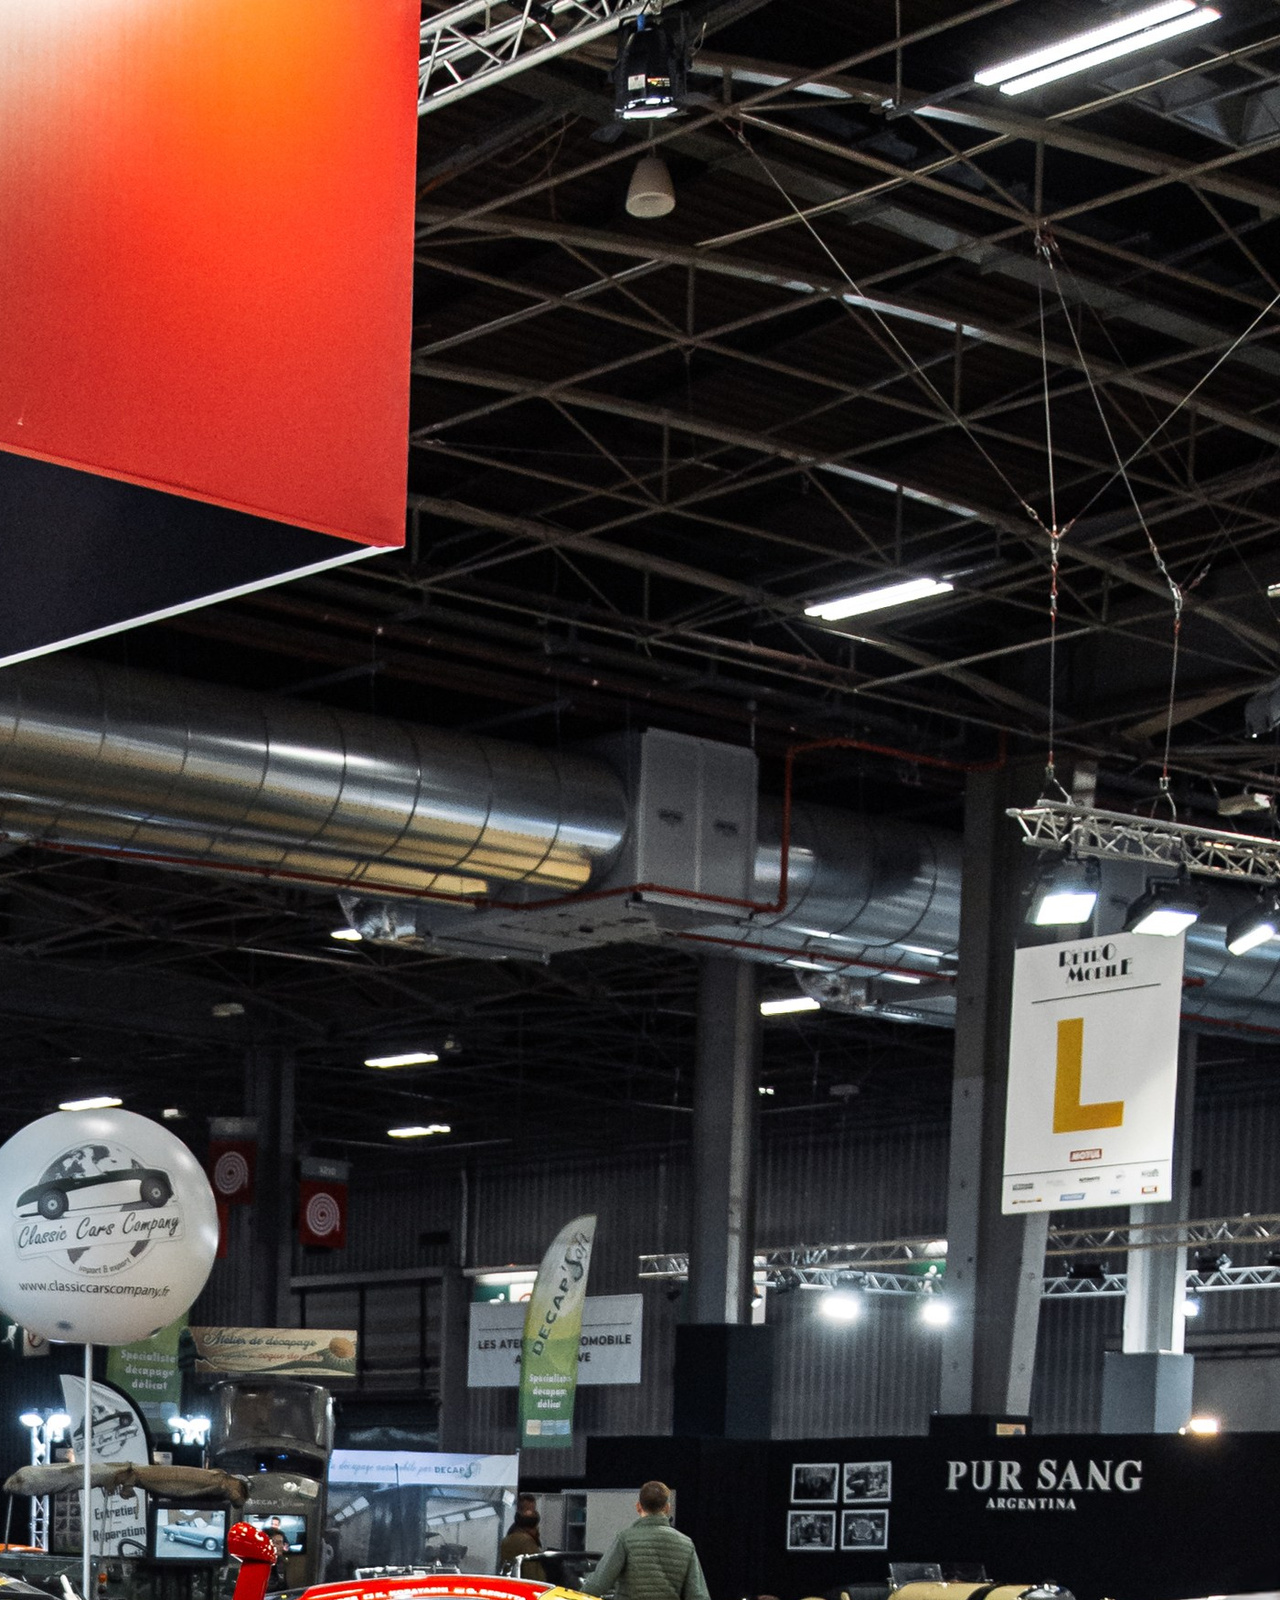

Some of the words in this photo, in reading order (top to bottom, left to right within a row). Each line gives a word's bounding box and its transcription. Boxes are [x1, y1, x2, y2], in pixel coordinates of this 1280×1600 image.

[1052, 1016, 1125, 1134] L
[19, 1225, 68, 1249] Classic
[76, 1216, 115, 1240] Cars
[122, 1211, 180, 1239] Company
[78, 1264, 102, 1274] import
[109, 1257, 132, 1273] export
[19, 1280, 170, 1298] www.classiccarscompany.fr
[478, 1340, 497, 1350] LES
[945, 1459, 1024, 1491] PUR
[1036, 1458, 1143, 1492] SANG
[985, 1497, 1076, 1510] ARGENTINA
